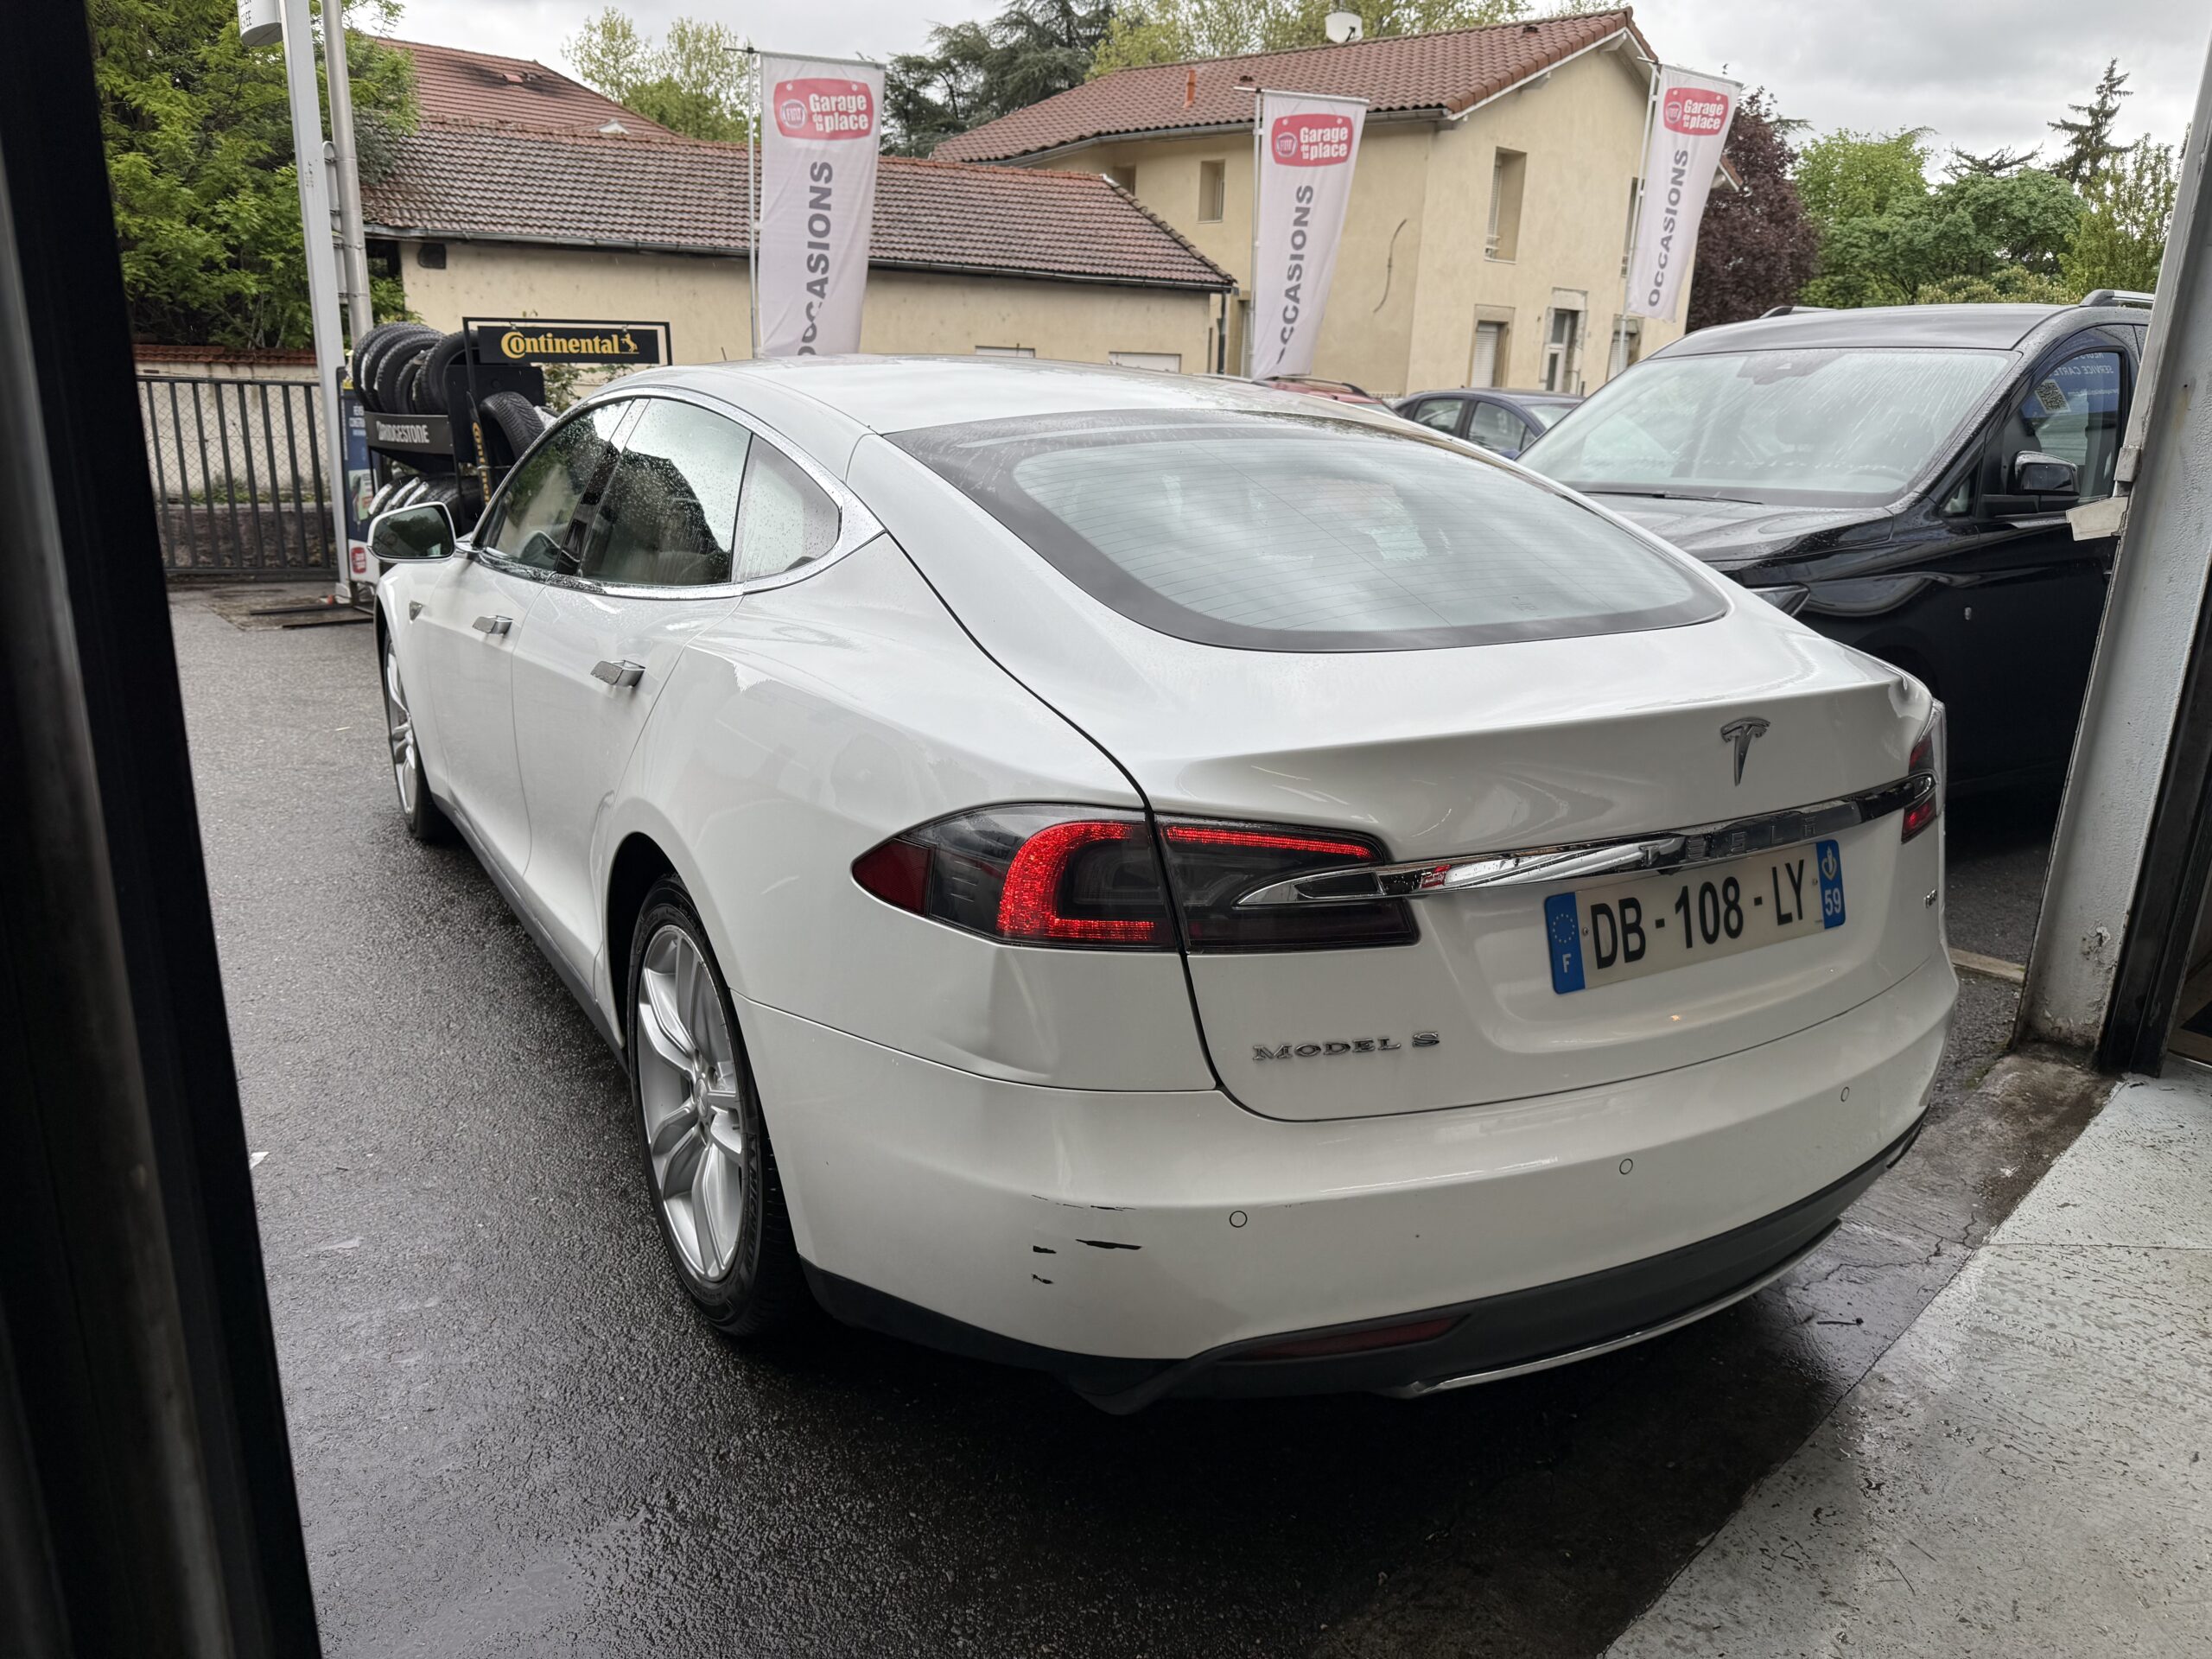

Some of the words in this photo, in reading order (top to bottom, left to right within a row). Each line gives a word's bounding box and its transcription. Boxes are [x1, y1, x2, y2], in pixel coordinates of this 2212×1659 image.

[809, 92, 868, 113] Garage
[1683, 99, 1725, 117] Garage
[823, 112, 869, 133] place
[1689, 114, 1721, 130] place
[1300, 126, 1348, 143] Garage
[1310, 142, 1348, 161] place
[1648, 149, 1688, 307] OCCASIONS
[1276, 185, 1313, 365] CCASIONS
[500, 331, 620, 359] Continental
[1823, 887, 1842, 917] 59
[1590, 859, 1805, 969] DB-108-LY
[1561, 953, 1572, 973] F
[1252, 1037, 1402, 1061] MODEL
[1412, 1032, 1440, 1048] S
